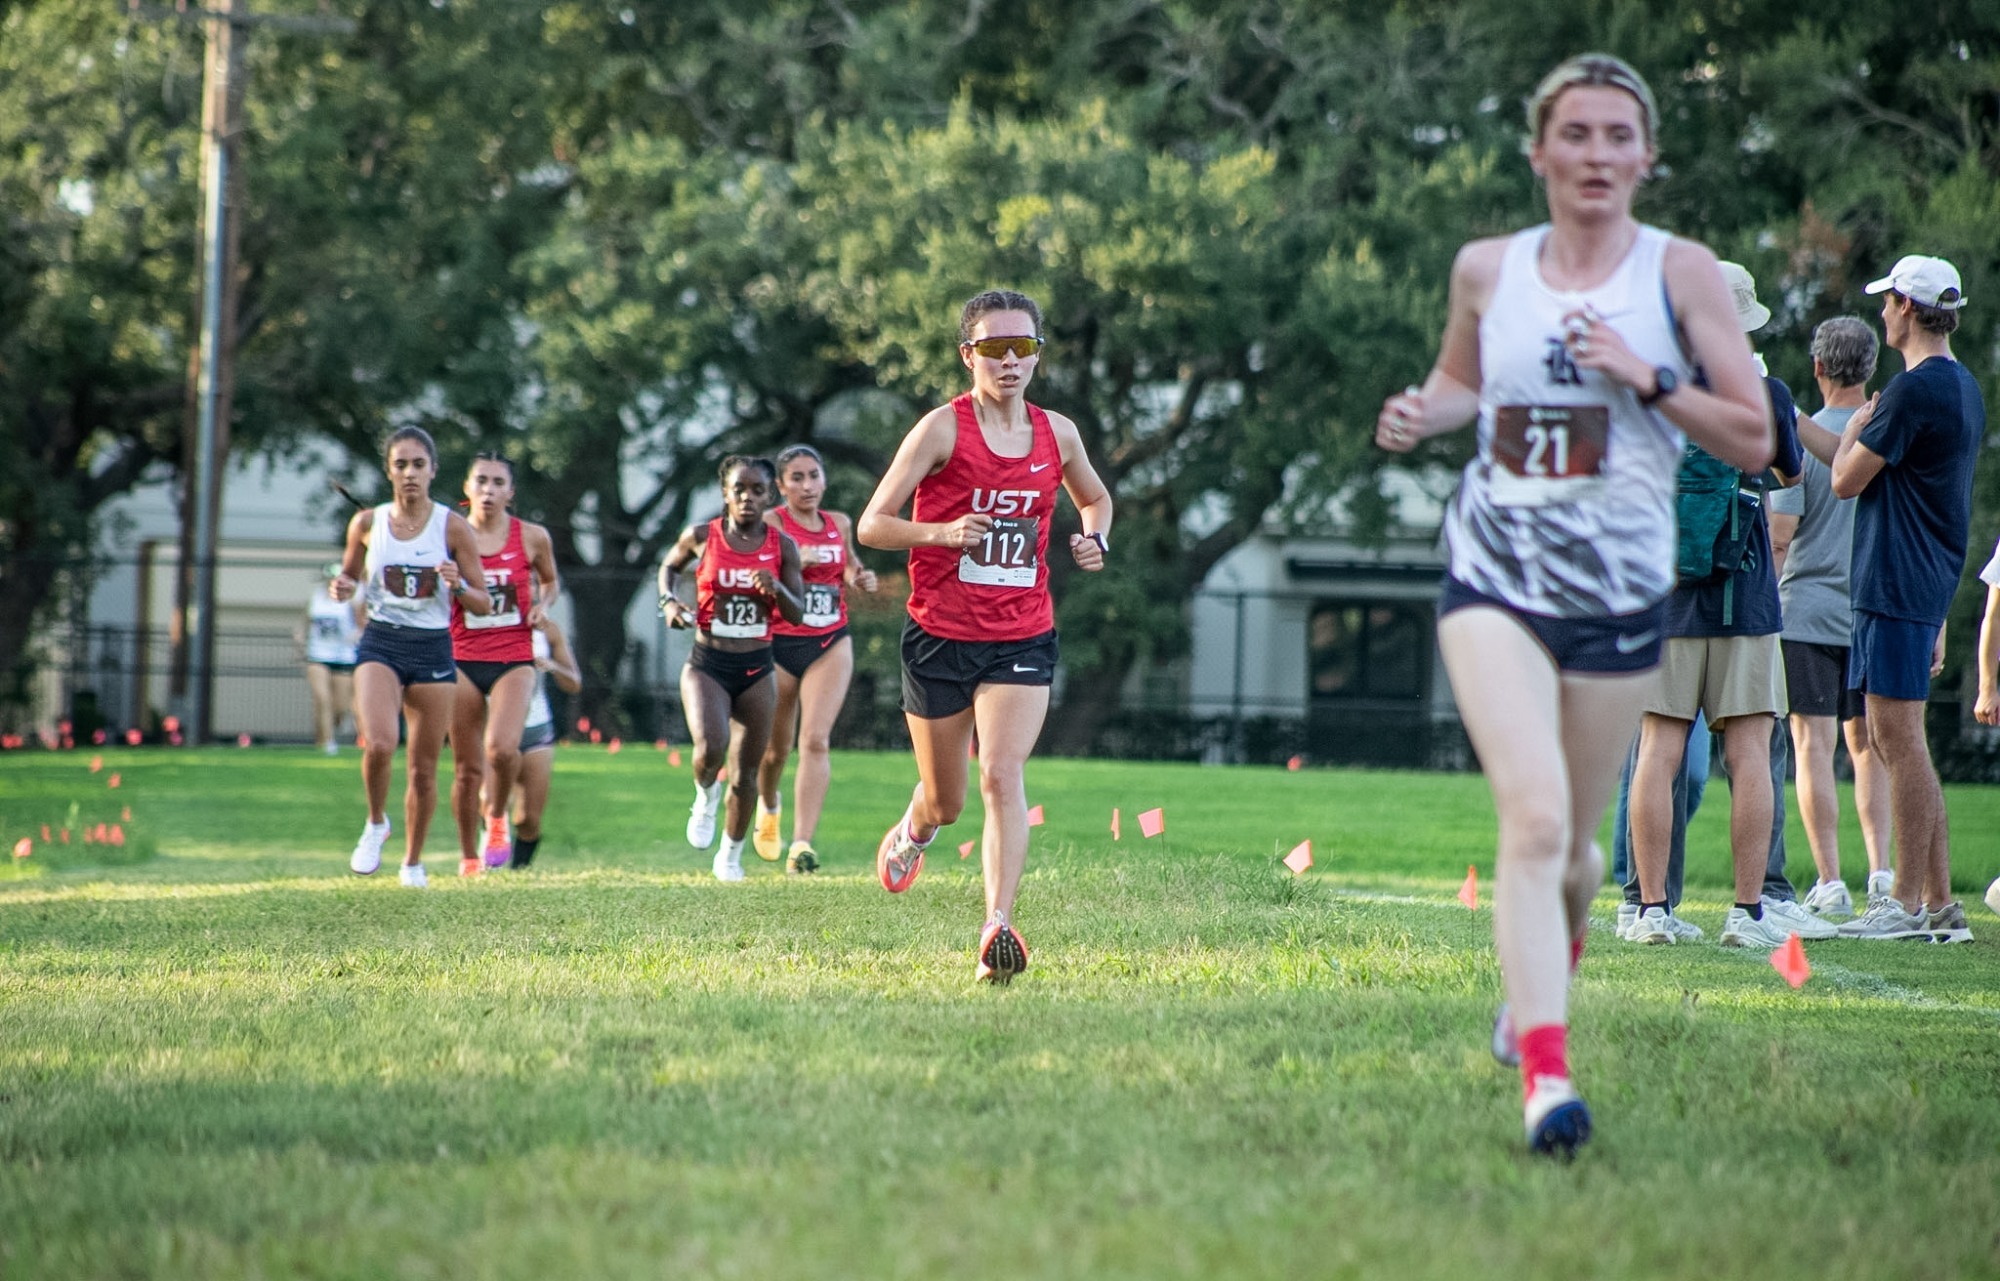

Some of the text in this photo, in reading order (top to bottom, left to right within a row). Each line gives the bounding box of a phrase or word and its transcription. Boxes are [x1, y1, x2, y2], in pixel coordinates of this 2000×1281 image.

[1524, 425, 1569, 475] 21
[971, 488, 1040, 514] UST
[983, 532, 1025, 564] 112
[405, 575, 418, 597] 8
[482, 568, 512, 587] ST
[718, 568, 755, 588] US
[725, 602, 757, 624] 123
